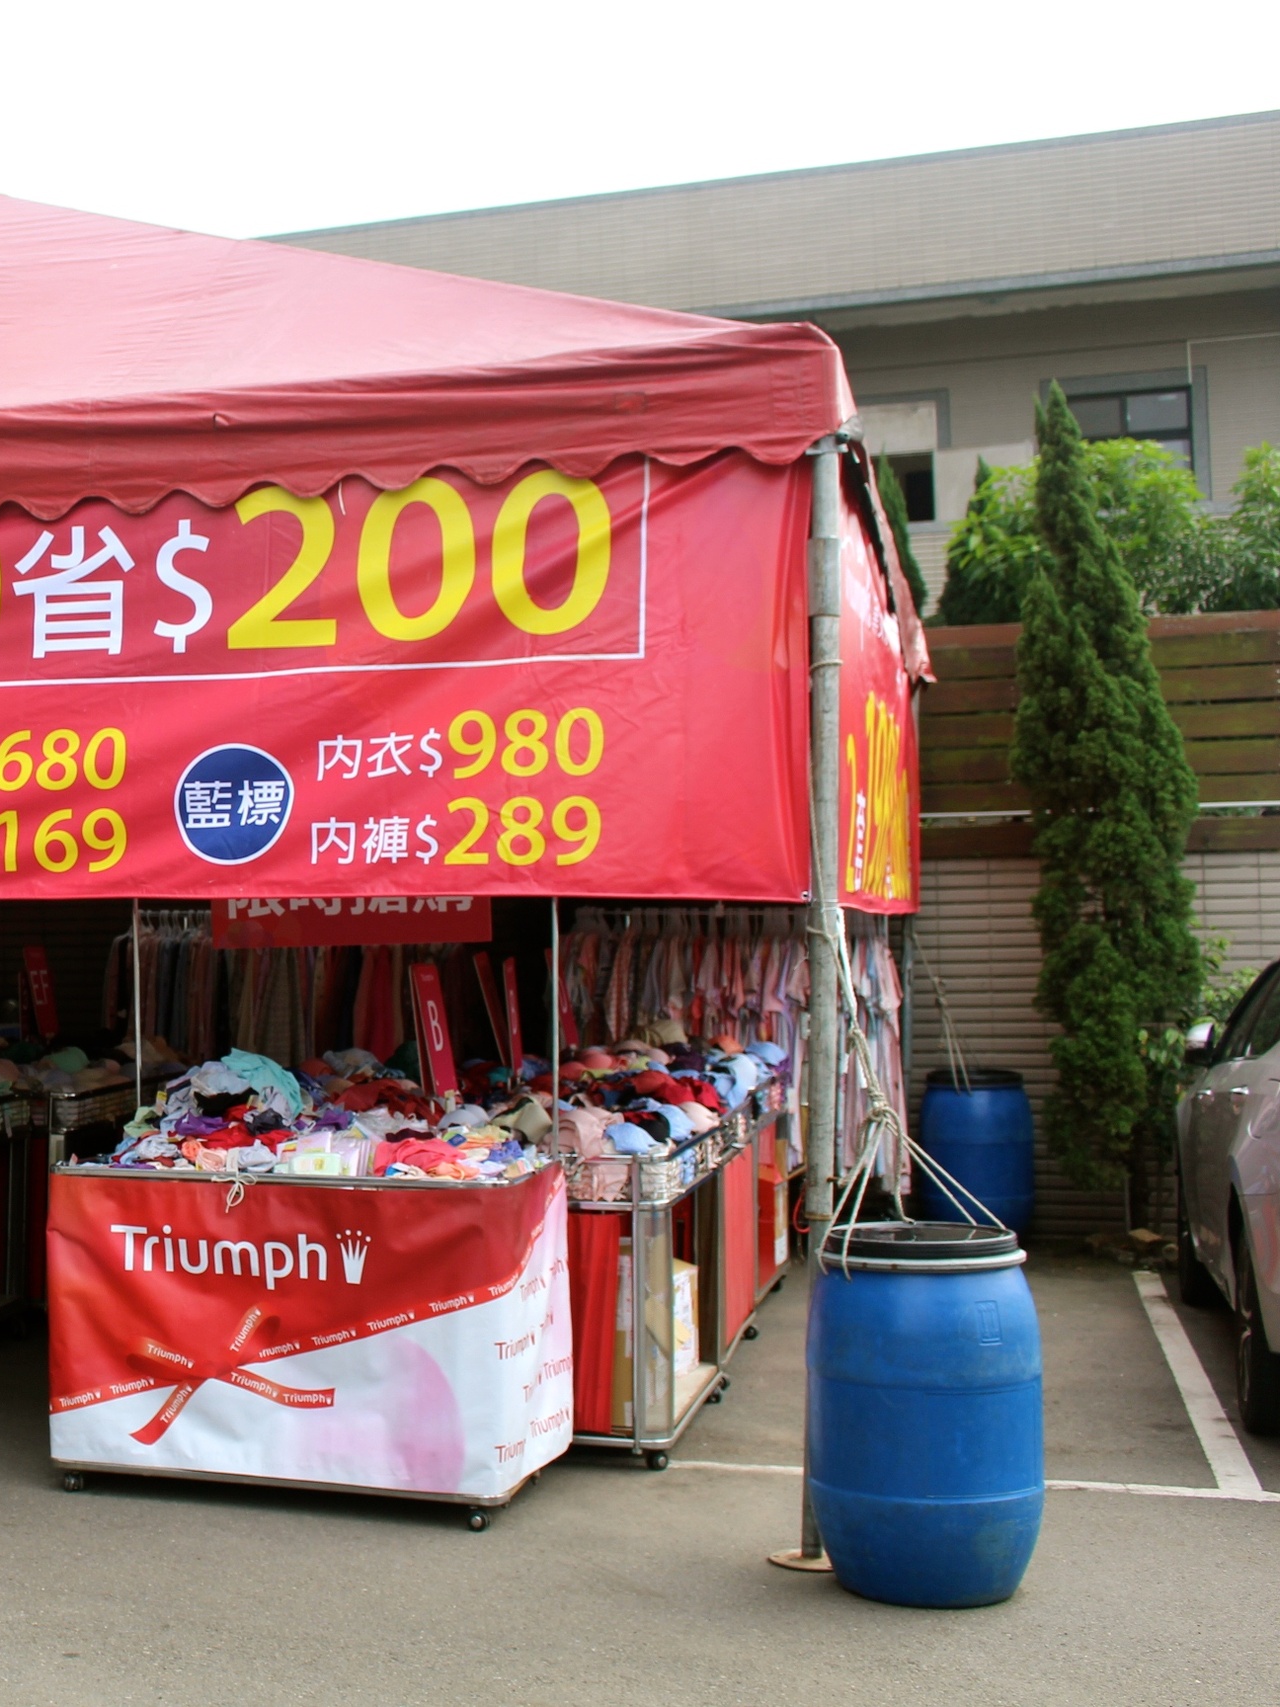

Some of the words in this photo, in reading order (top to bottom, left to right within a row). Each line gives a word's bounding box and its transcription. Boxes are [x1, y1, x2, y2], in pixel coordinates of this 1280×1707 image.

[184, 779, 286, 829] 藍標
[426, 999, 444, 1051] B
[110, 1224, 328, 1291] Triumph
[428, 1295, 468, 1313] Triumph
[229, 1311, 257, 1353] Triumph
[366, 1312, 408, 1332] Triumph
[259, 1341, 294, 1358] riumph
[311, 1330, 351, 1346] Triumph
[147, 1343, 187, 1368] Triumph
[109, 1378, 148, 1395] Triumph
[231, 1371, 272, 1396] Triumph
[59, 1391, 95, 1408] Triumph
[159, 1390, 188, 1425] Triumph
[282, 1392, 326, 1404] Triumph
[494, 1438, 527, 1464] Trium
